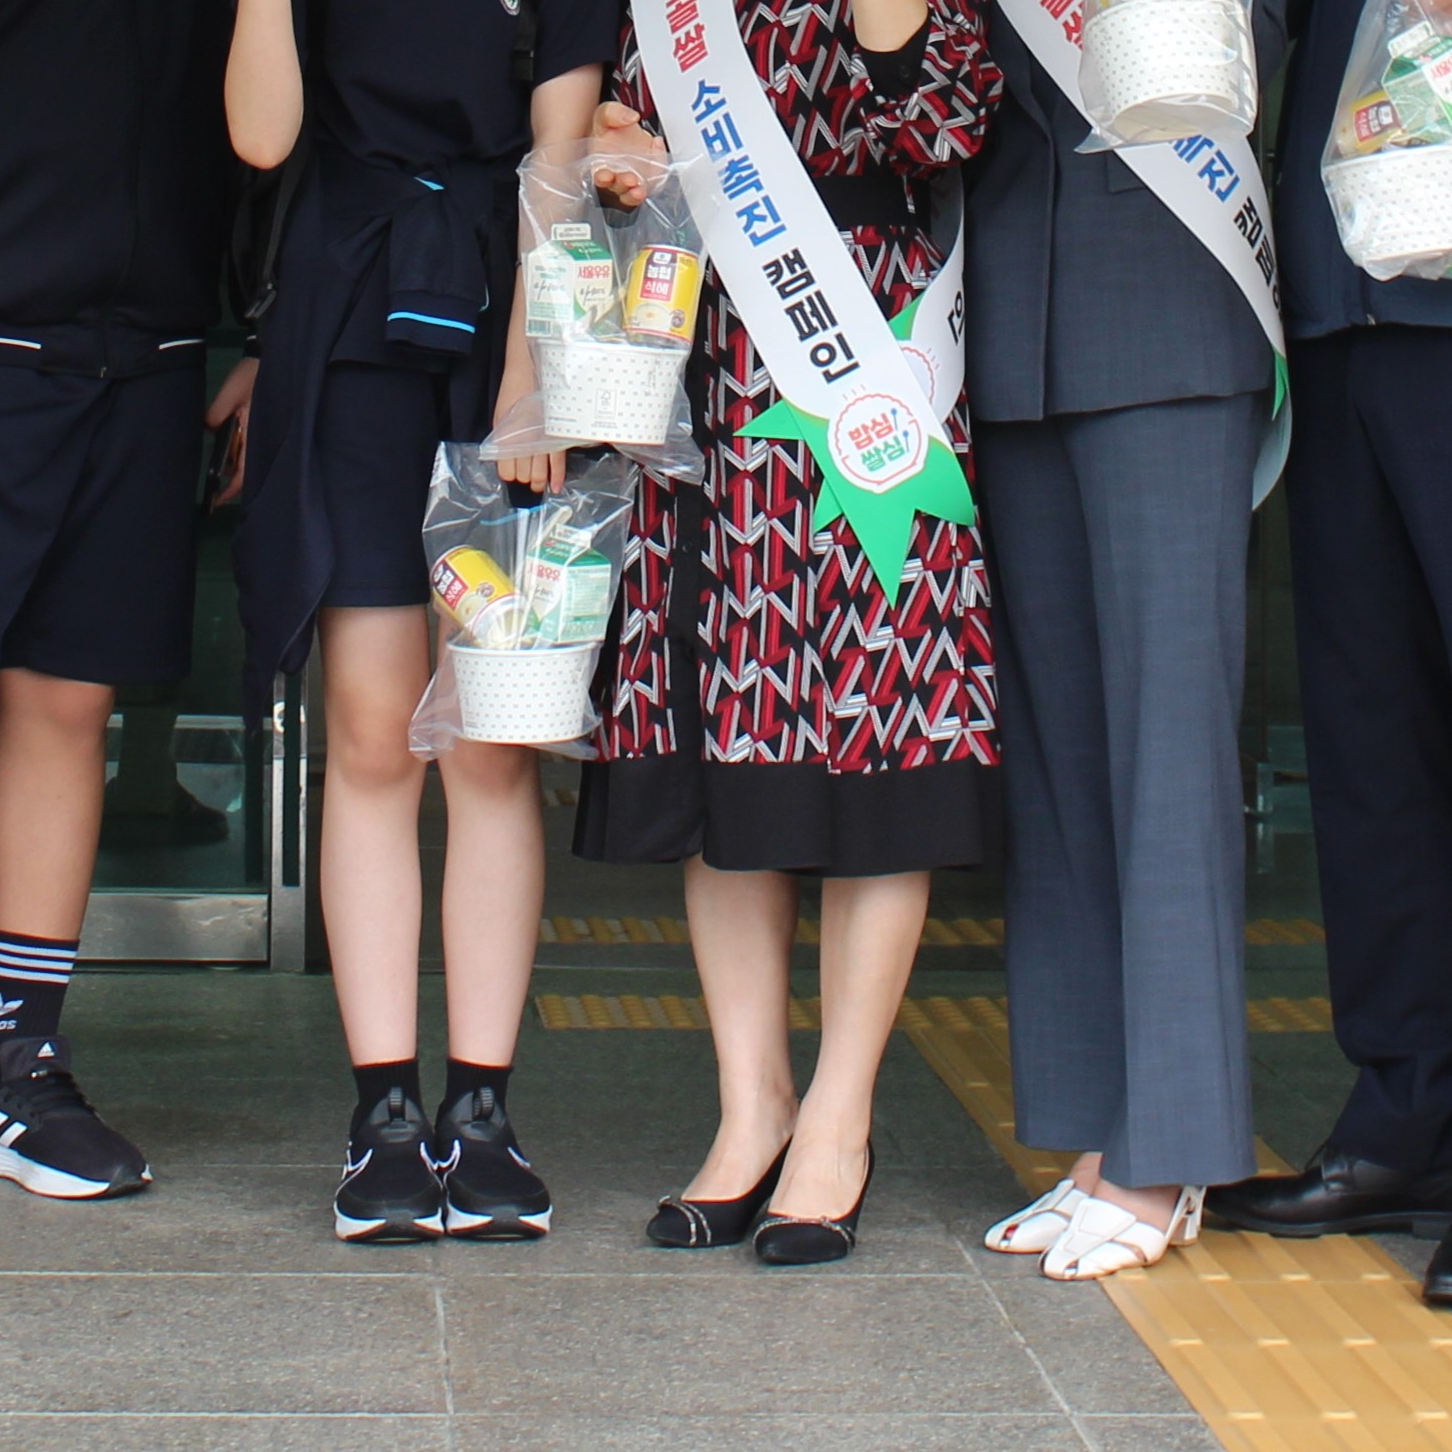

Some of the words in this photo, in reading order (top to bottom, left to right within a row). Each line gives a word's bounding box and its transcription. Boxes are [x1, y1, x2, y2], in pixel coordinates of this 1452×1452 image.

[690, 78, 788, 249] 소비촉진
[762, 246, 862, 385] 캠페인
[577, 265, 611, 279] 서울우유
[646, 265, 672, 281] 농협
[644, 279, 669, 296] 식혜
[847, 412, 895, 450] 밥심
[860, 435, 906, 473] 쌀심
